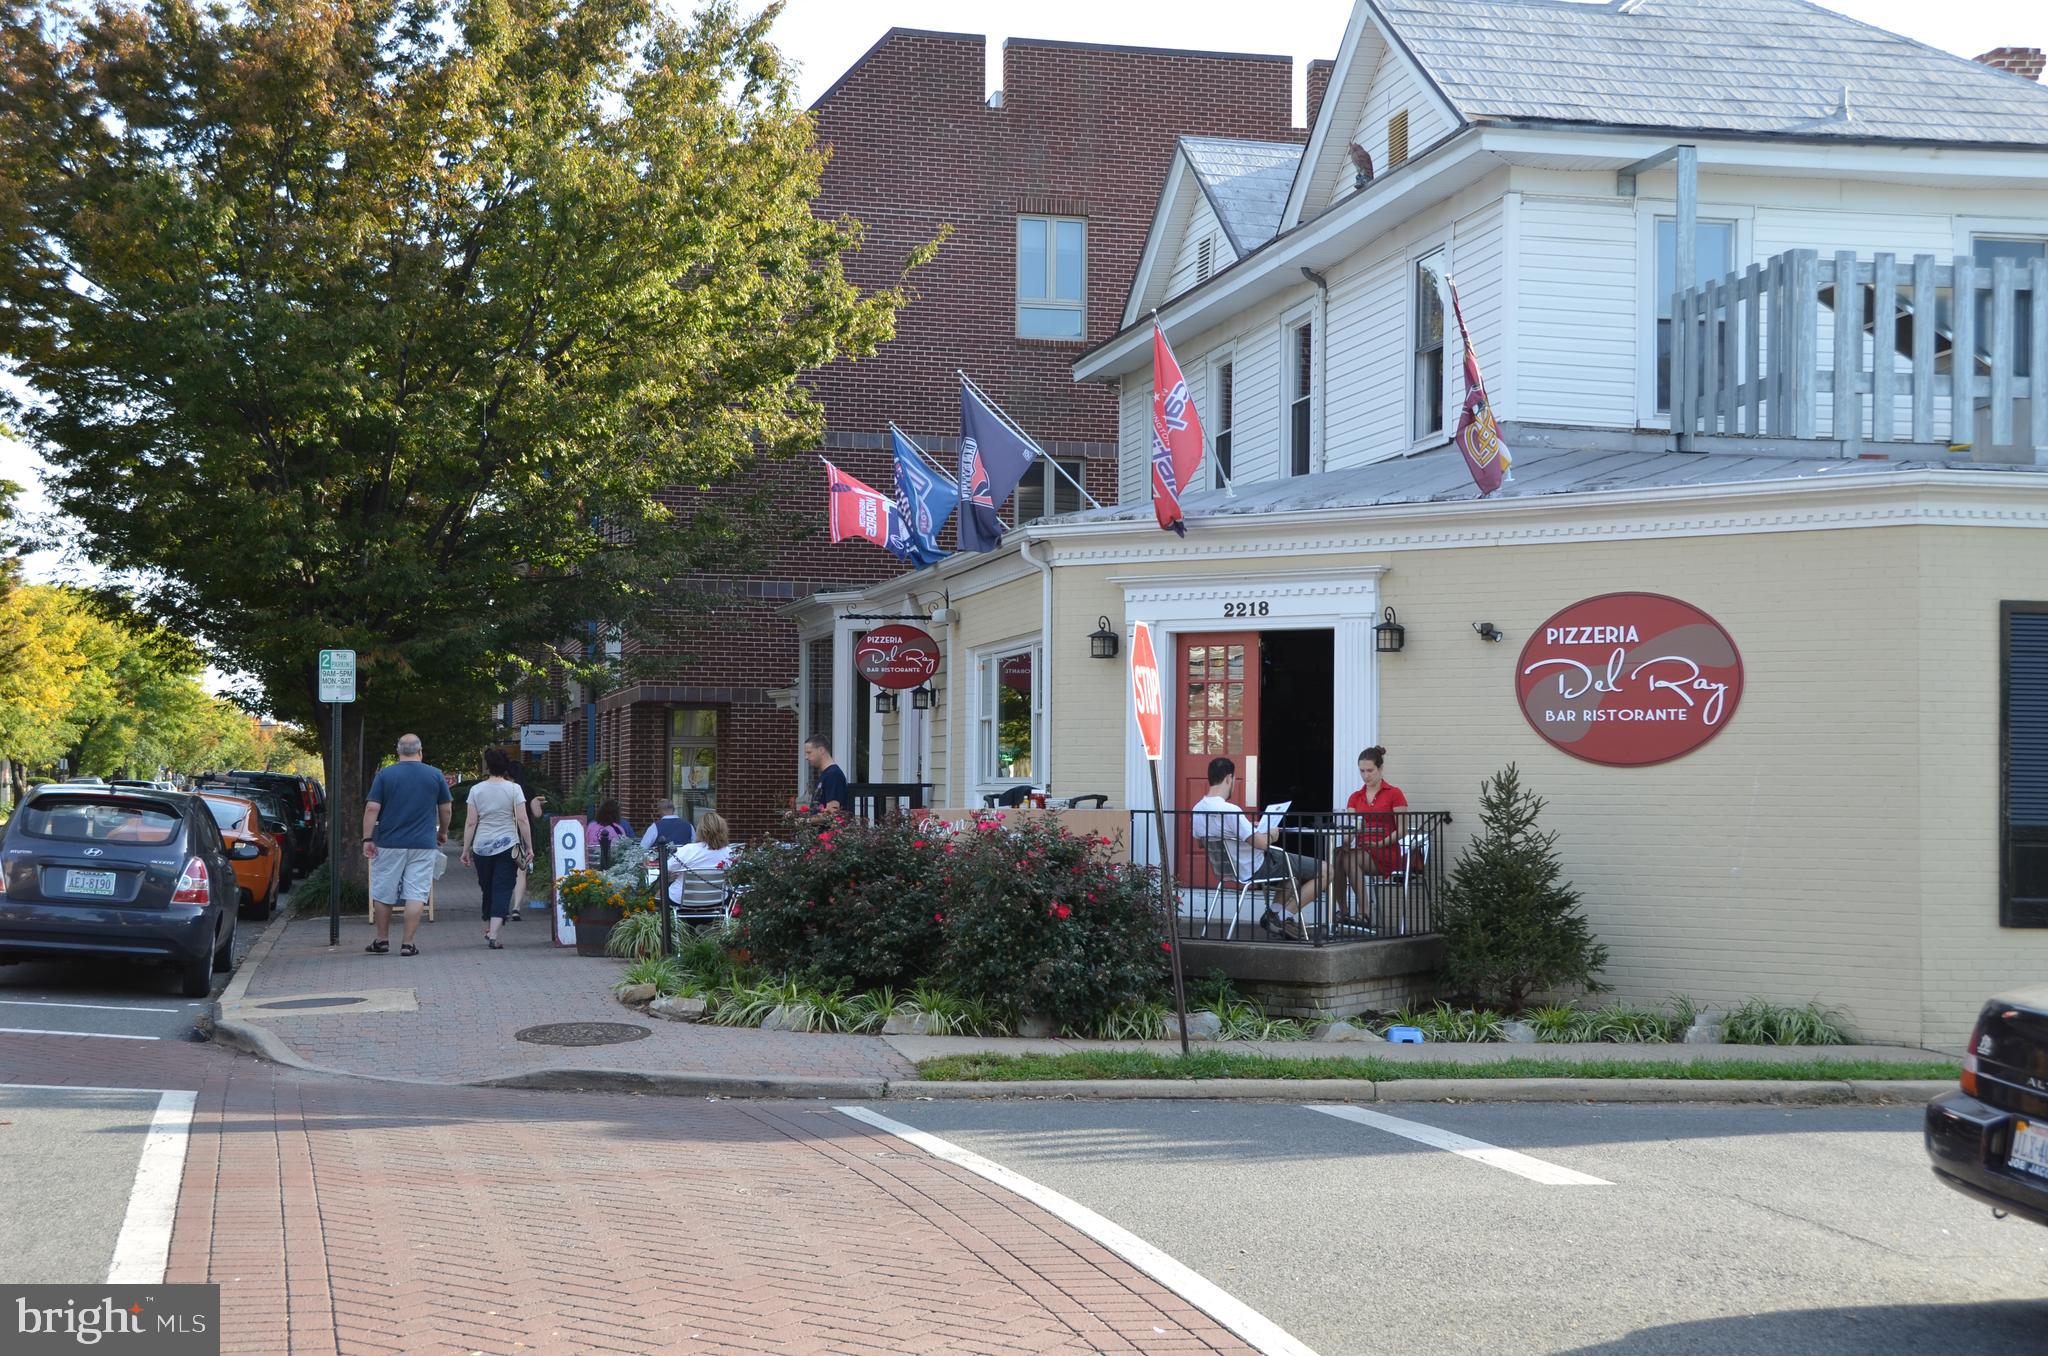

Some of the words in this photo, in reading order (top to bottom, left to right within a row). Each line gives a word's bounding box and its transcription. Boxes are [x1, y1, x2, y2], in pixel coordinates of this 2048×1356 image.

[1224, 601, 1269, 618] 2218
[867, 636, 903, 644] PIZZERIA
[1546, 625, 1640, 645] PIZZERIA
[322, 654, 330, 667] 2
[858, 645, 897, 664] Del
[899, 648, 935, 674] Ray
[1134, 665, 1159, 715] STOP
[1524, 647, 1625, 699] Del
[1631, 655, 1729, 725] Ray
[1545, 709, 1576, 722] BAR
[1583, 708, 1688, 722] RISTORANTE
[69, 876, 111, 890] AEJ-8190
